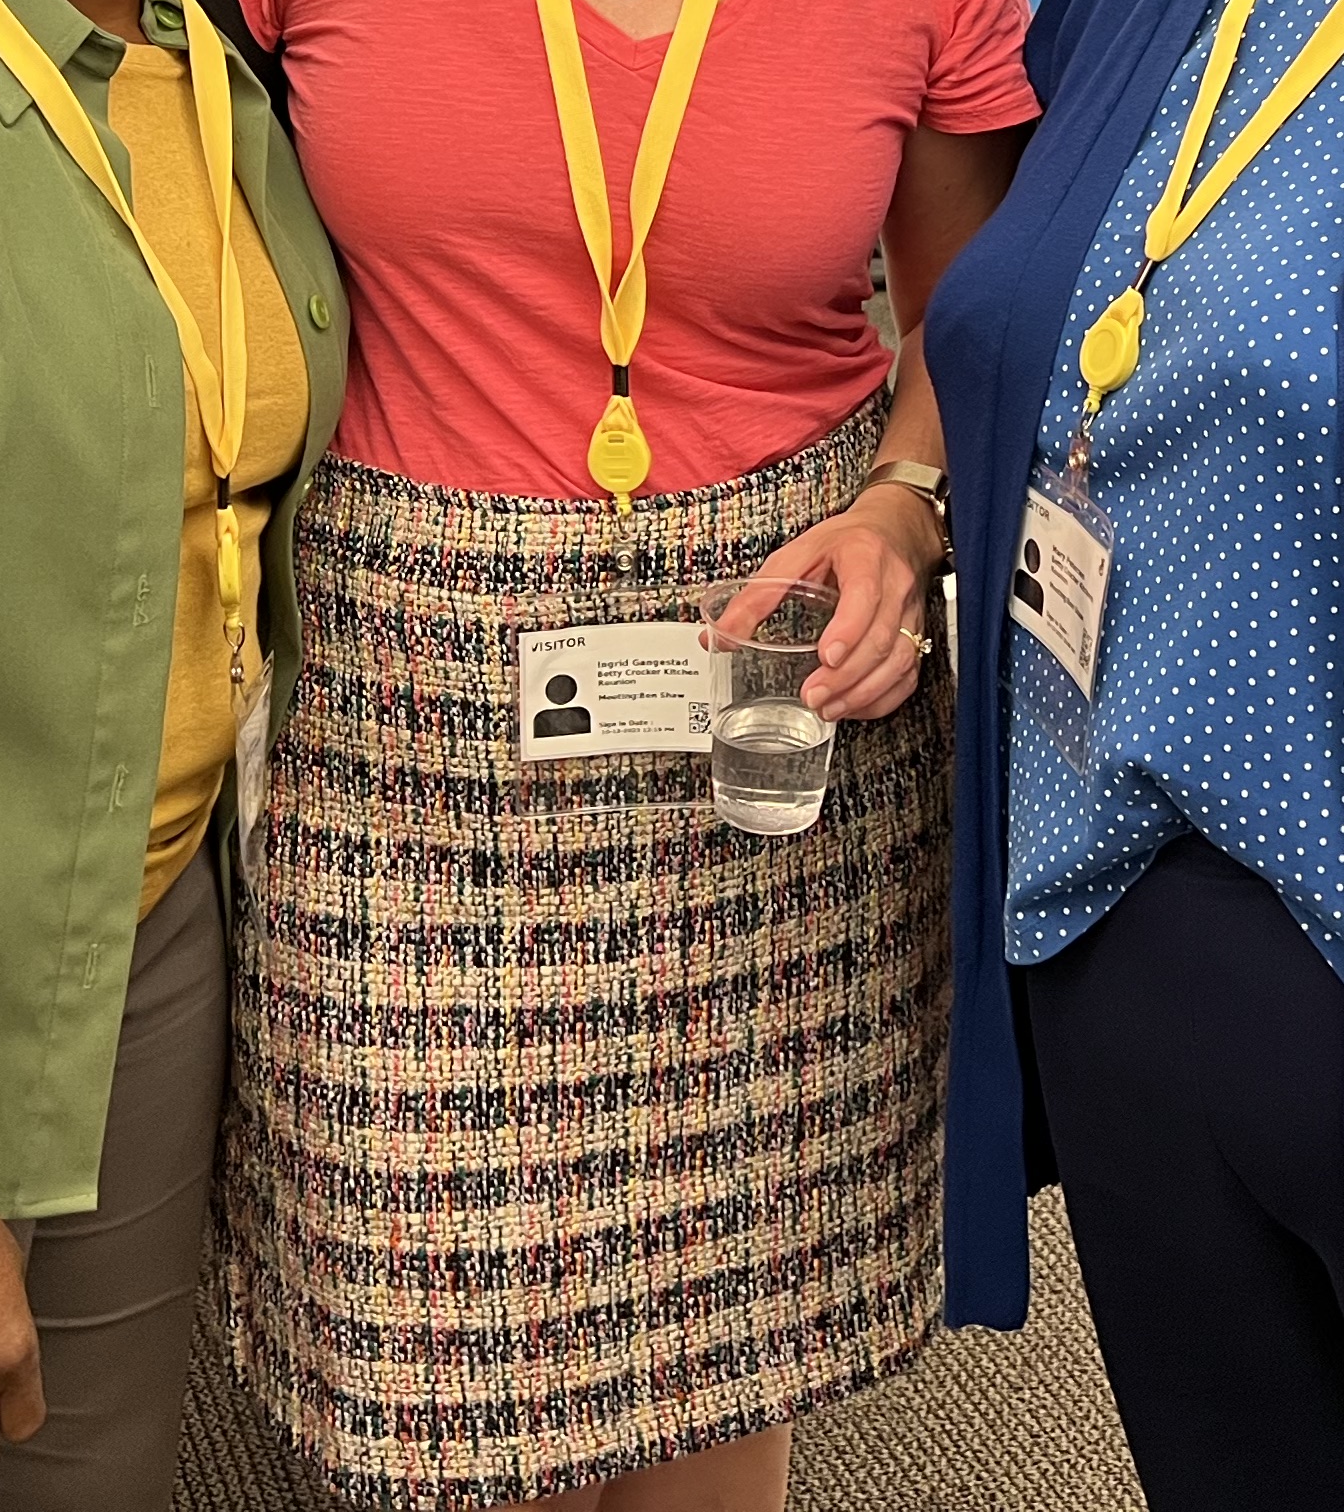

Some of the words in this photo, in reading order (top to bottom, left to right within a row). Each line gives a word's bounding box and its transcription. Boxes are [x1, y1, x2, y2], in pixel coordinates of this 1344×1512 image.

[531, 636, 586, 652] VISITOR
[598, 659, 629, 669] Ingrid
[632, 658, 689, 667] Gangestad
[598, 670, 622, 678] Betty
[625, 668, 661, 676] Crocker
